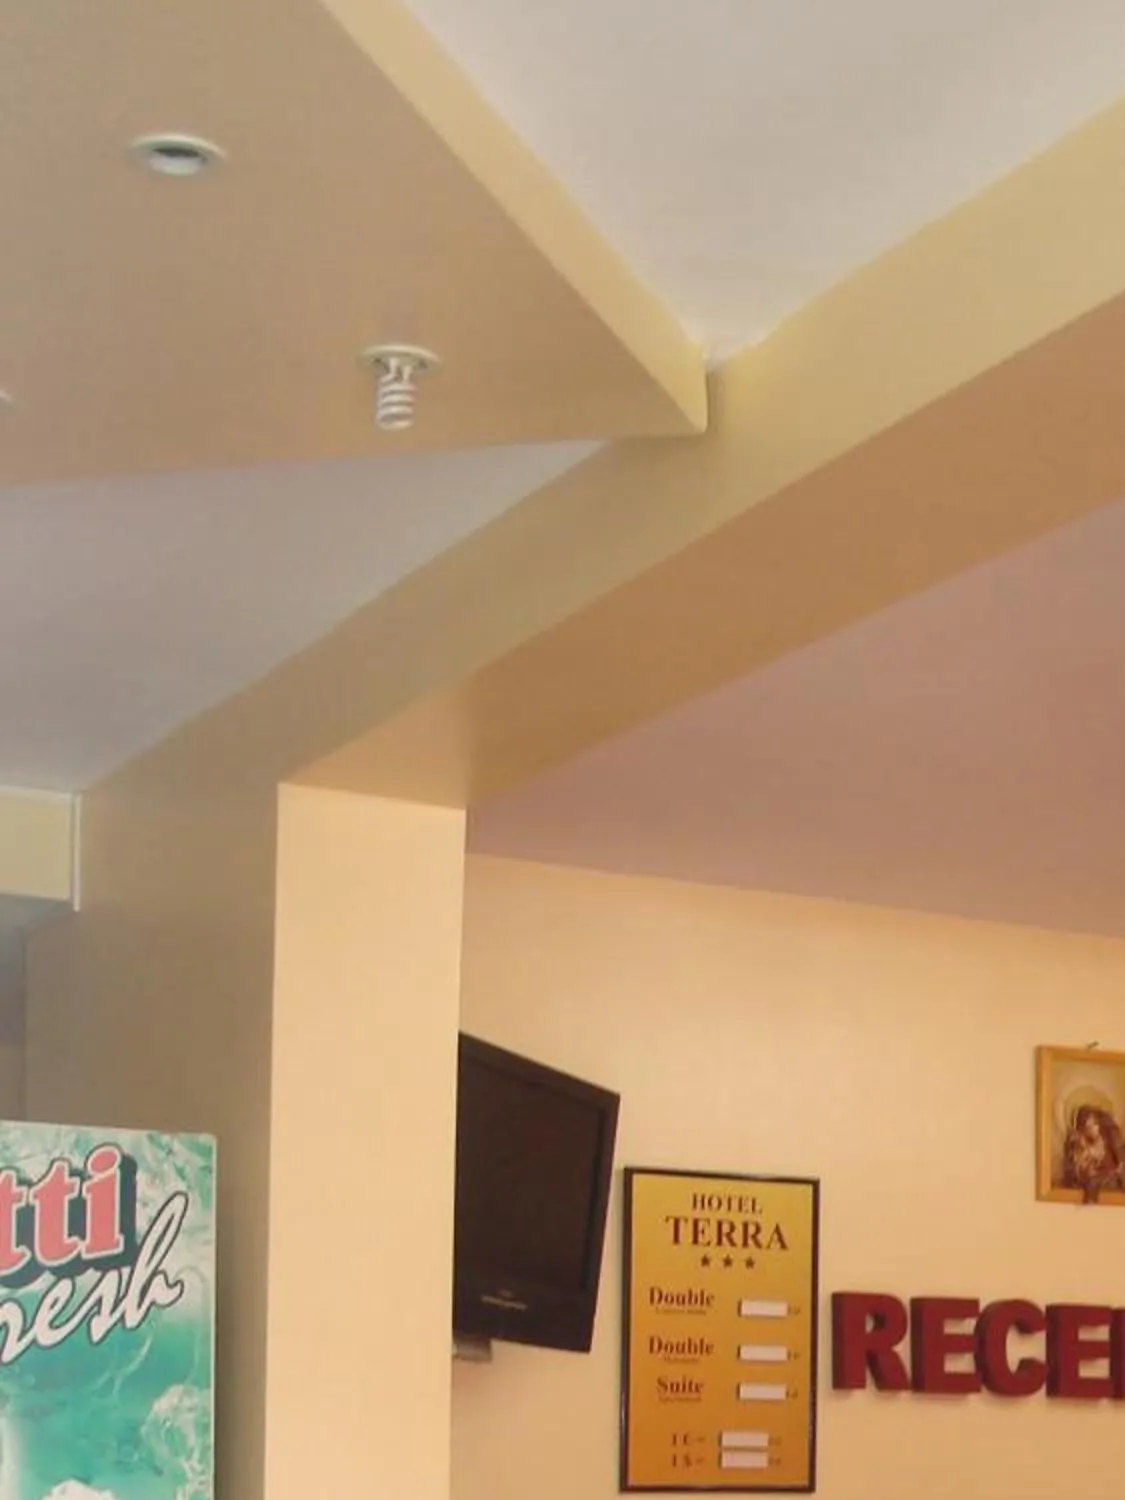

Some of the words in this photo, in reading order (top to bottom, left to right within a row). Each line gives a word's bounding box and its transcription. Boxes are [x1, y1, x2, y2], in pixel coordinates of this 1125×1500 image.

[691, 1192, 763, 1214] HOTEL
[665, 1216, 789, 1250] TERRA
[649, 1286, 715, 1307] Double
[649, 1335, 715, 1356] Double
[656, 1375, 704, 1394] Suite
